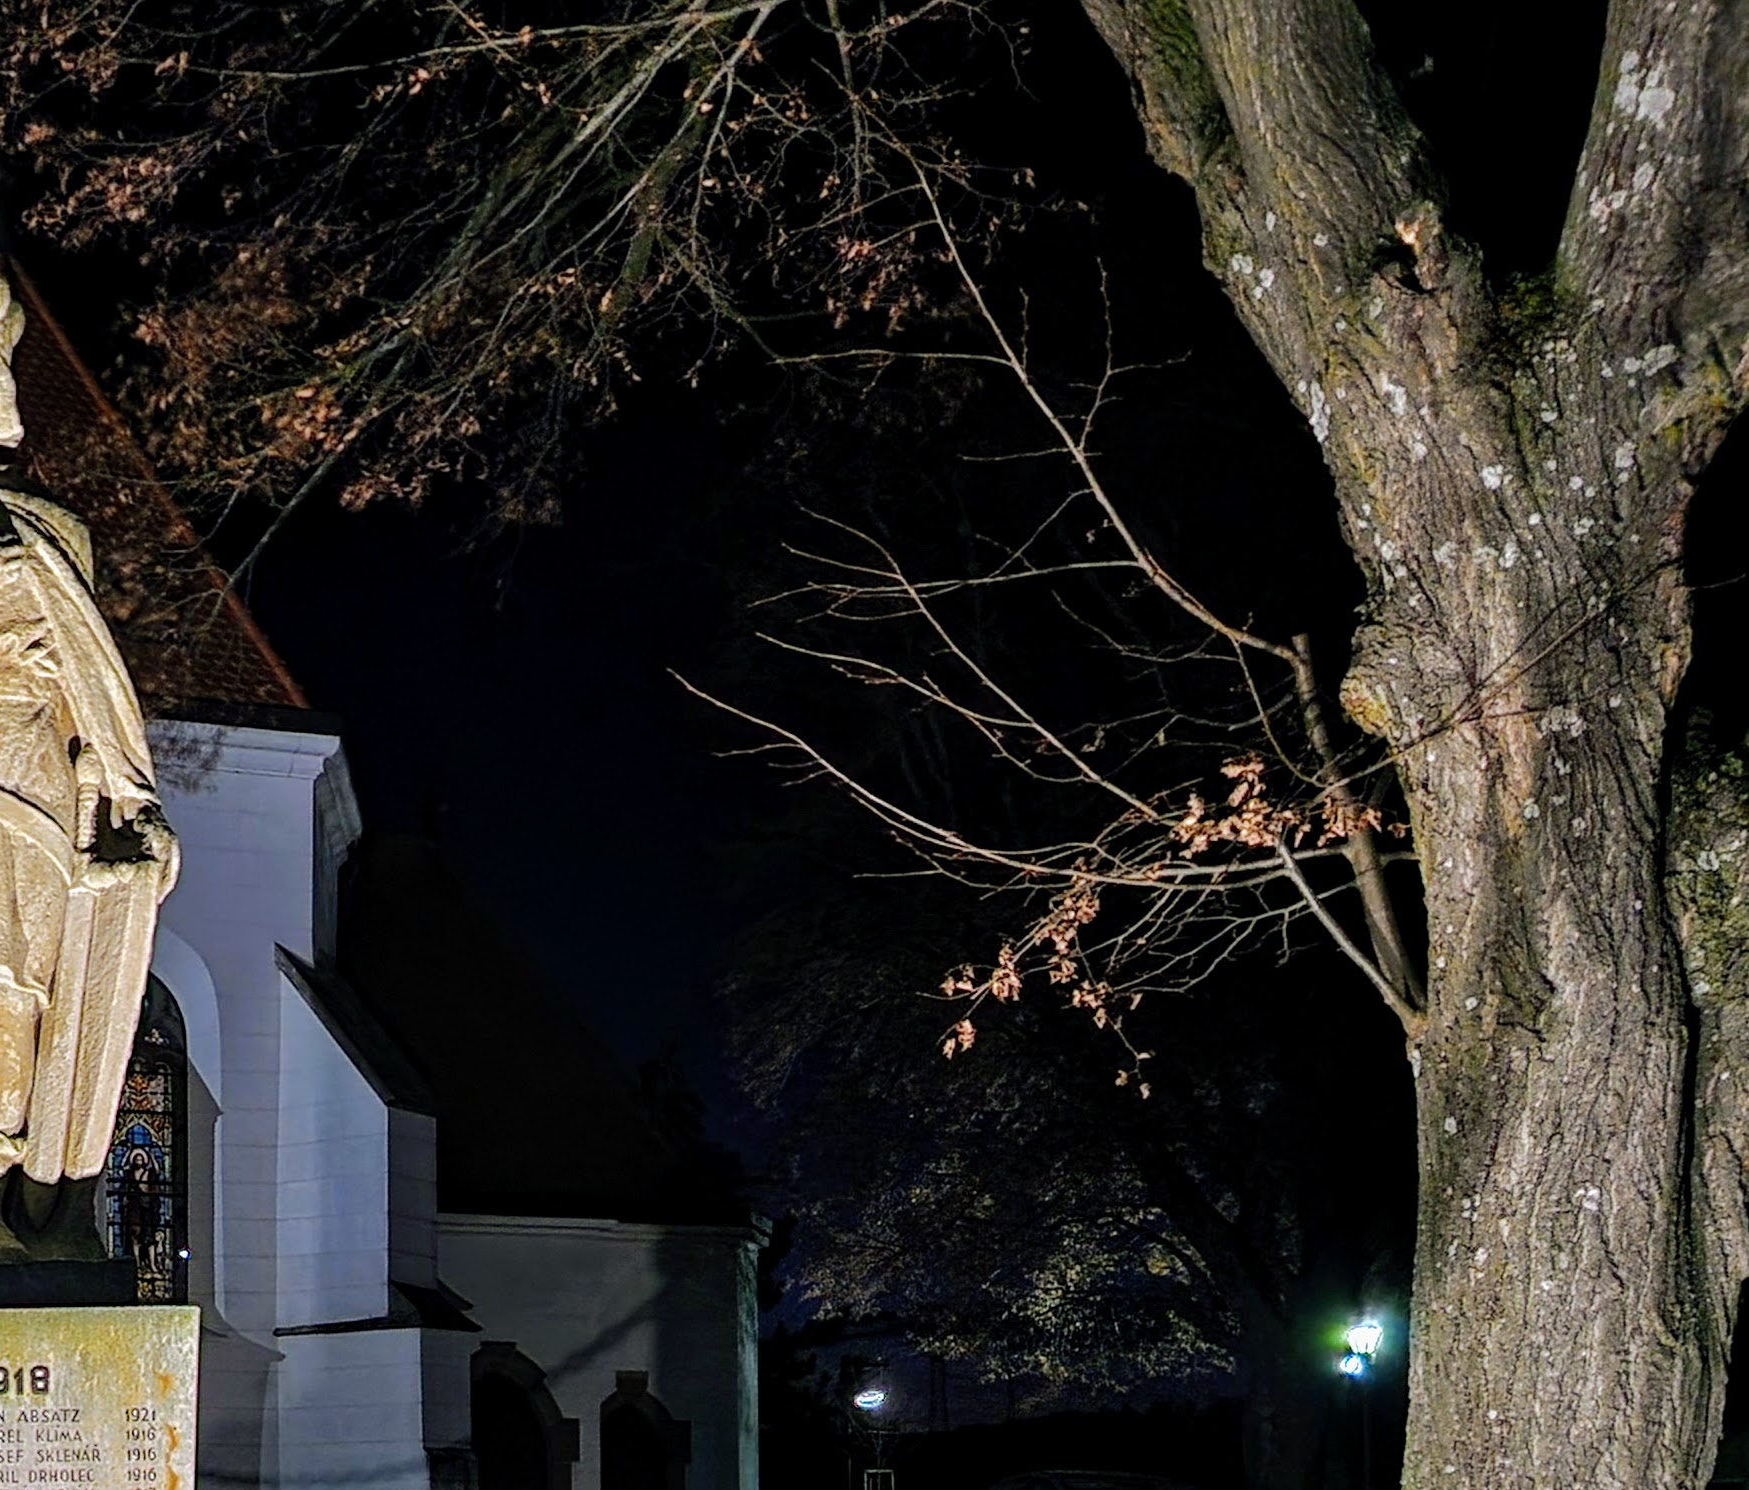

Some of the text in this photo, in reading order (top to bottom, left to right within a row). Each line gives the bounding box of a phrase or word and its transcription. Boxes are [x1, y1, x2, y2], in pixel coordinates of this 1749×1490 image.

[17, 1409, 80, 1423] ABSATZ
[125, 1408, 157, 1421] 1921
[126, 1429, 156, 1441] 1916
[36, 1444, 101, 1462] SKLENÁŘ
[127, 1449, 157, 1461] 1916
[29, 1469, 96, 1483] DRHOLEC
[127, 1469, 157, 1481] 1916
